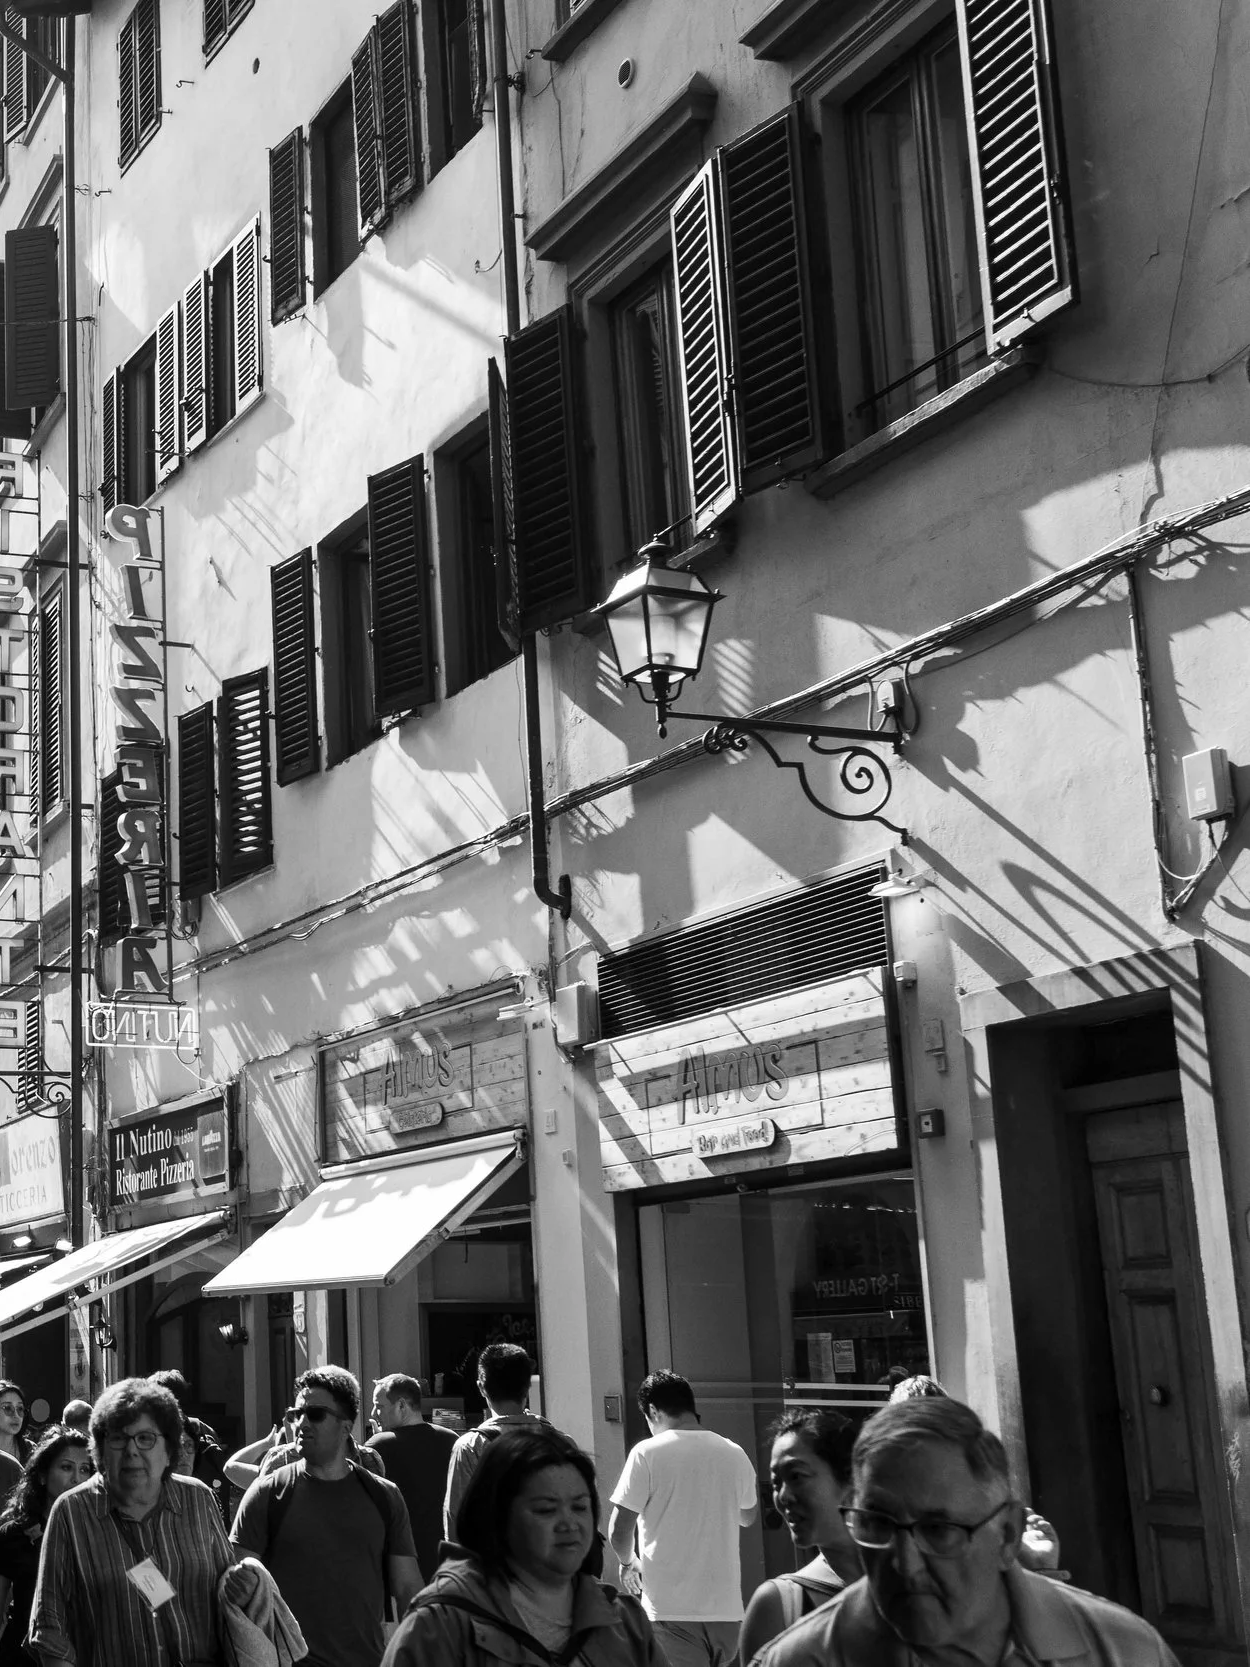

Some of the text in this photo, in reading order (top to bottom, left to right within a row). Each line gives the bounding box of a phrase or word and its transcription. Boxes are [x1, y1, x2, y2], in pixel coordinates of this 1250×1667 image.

[130, 1124, 172, 1158] Nutino
[116, 1152, 194, 1196] Ristorante Pizzeria
